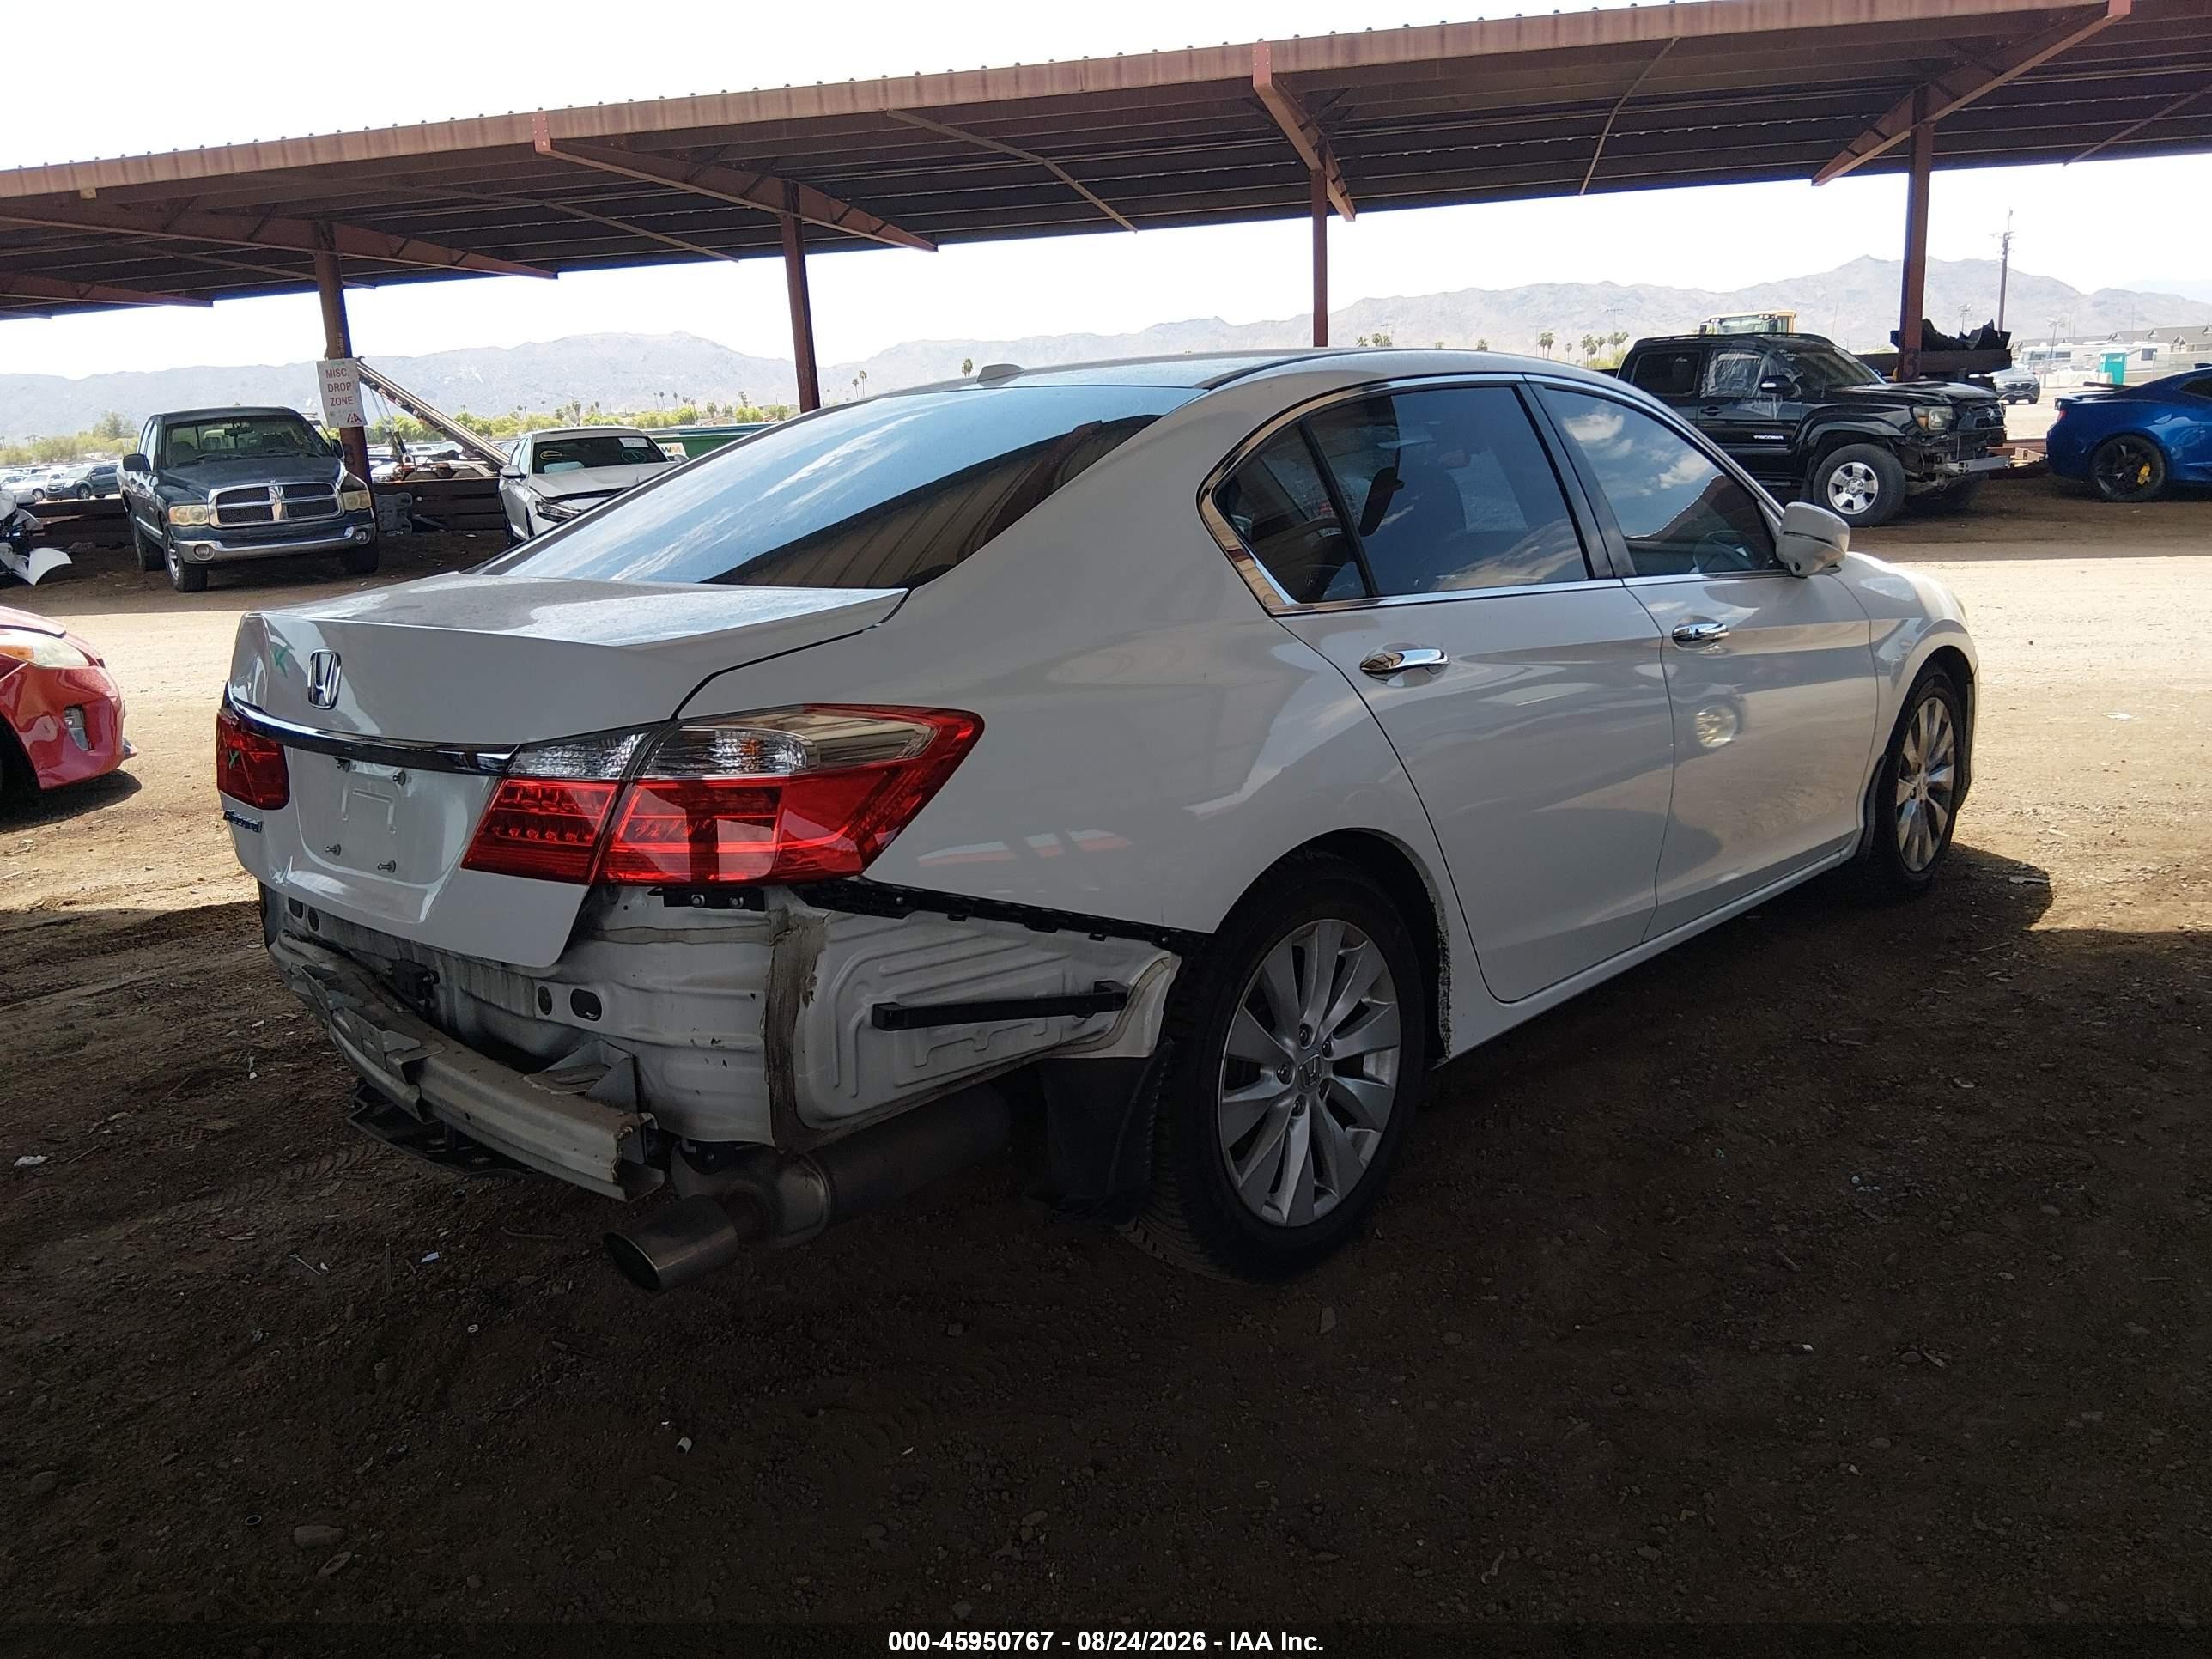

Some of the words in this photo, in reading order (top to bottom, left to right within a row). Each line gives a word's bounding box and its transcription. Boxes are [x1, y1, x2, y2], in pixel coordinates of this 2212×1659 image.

[325, 368, 350, 379] MISC.
[327, 382, 352, 392] DROP
[330, 396, 355, 407] ZONE
